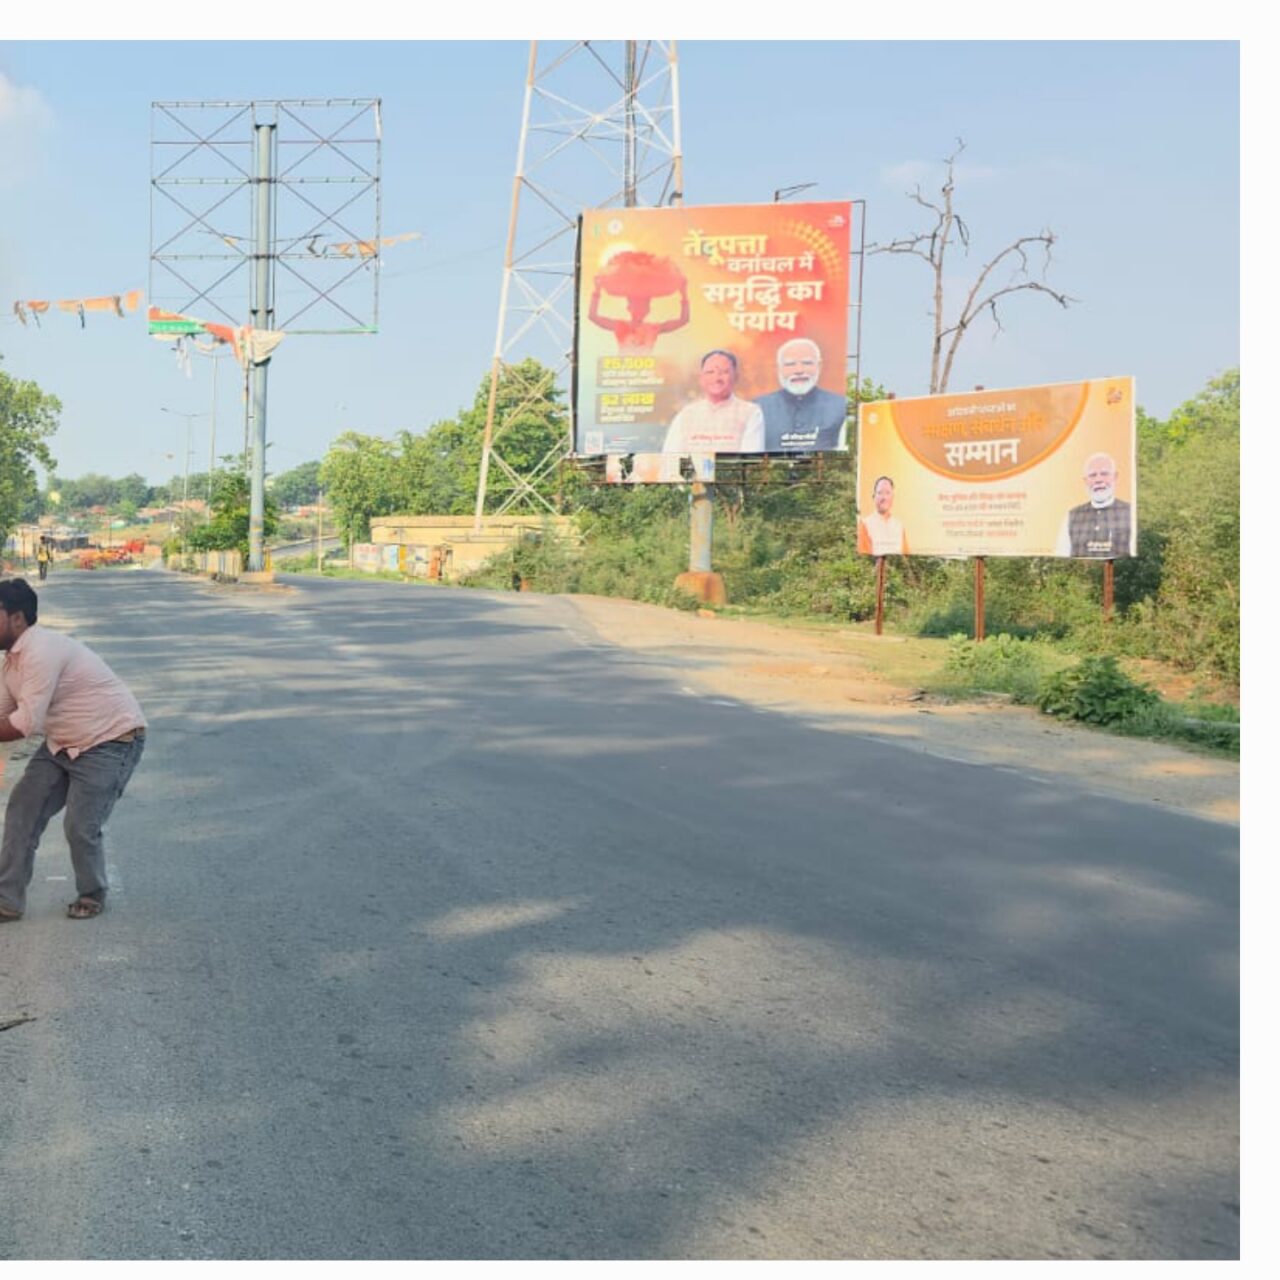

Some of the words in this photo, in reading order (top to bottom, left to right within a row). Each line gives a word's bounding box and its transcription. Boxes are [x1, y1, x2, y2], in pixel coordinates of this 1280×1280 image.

[682, 228, 768, 266] तेंदूपत्ता
[728, 253, 795, 272] वनांचल
[799, 250, 815, 271] में
[702, 275, 782, 309] समृद्धि
[786, 281, 824, 300] का
[727, 306, 798, 331] पर्याय
[943, 438, 1021, 466] सम्मान
